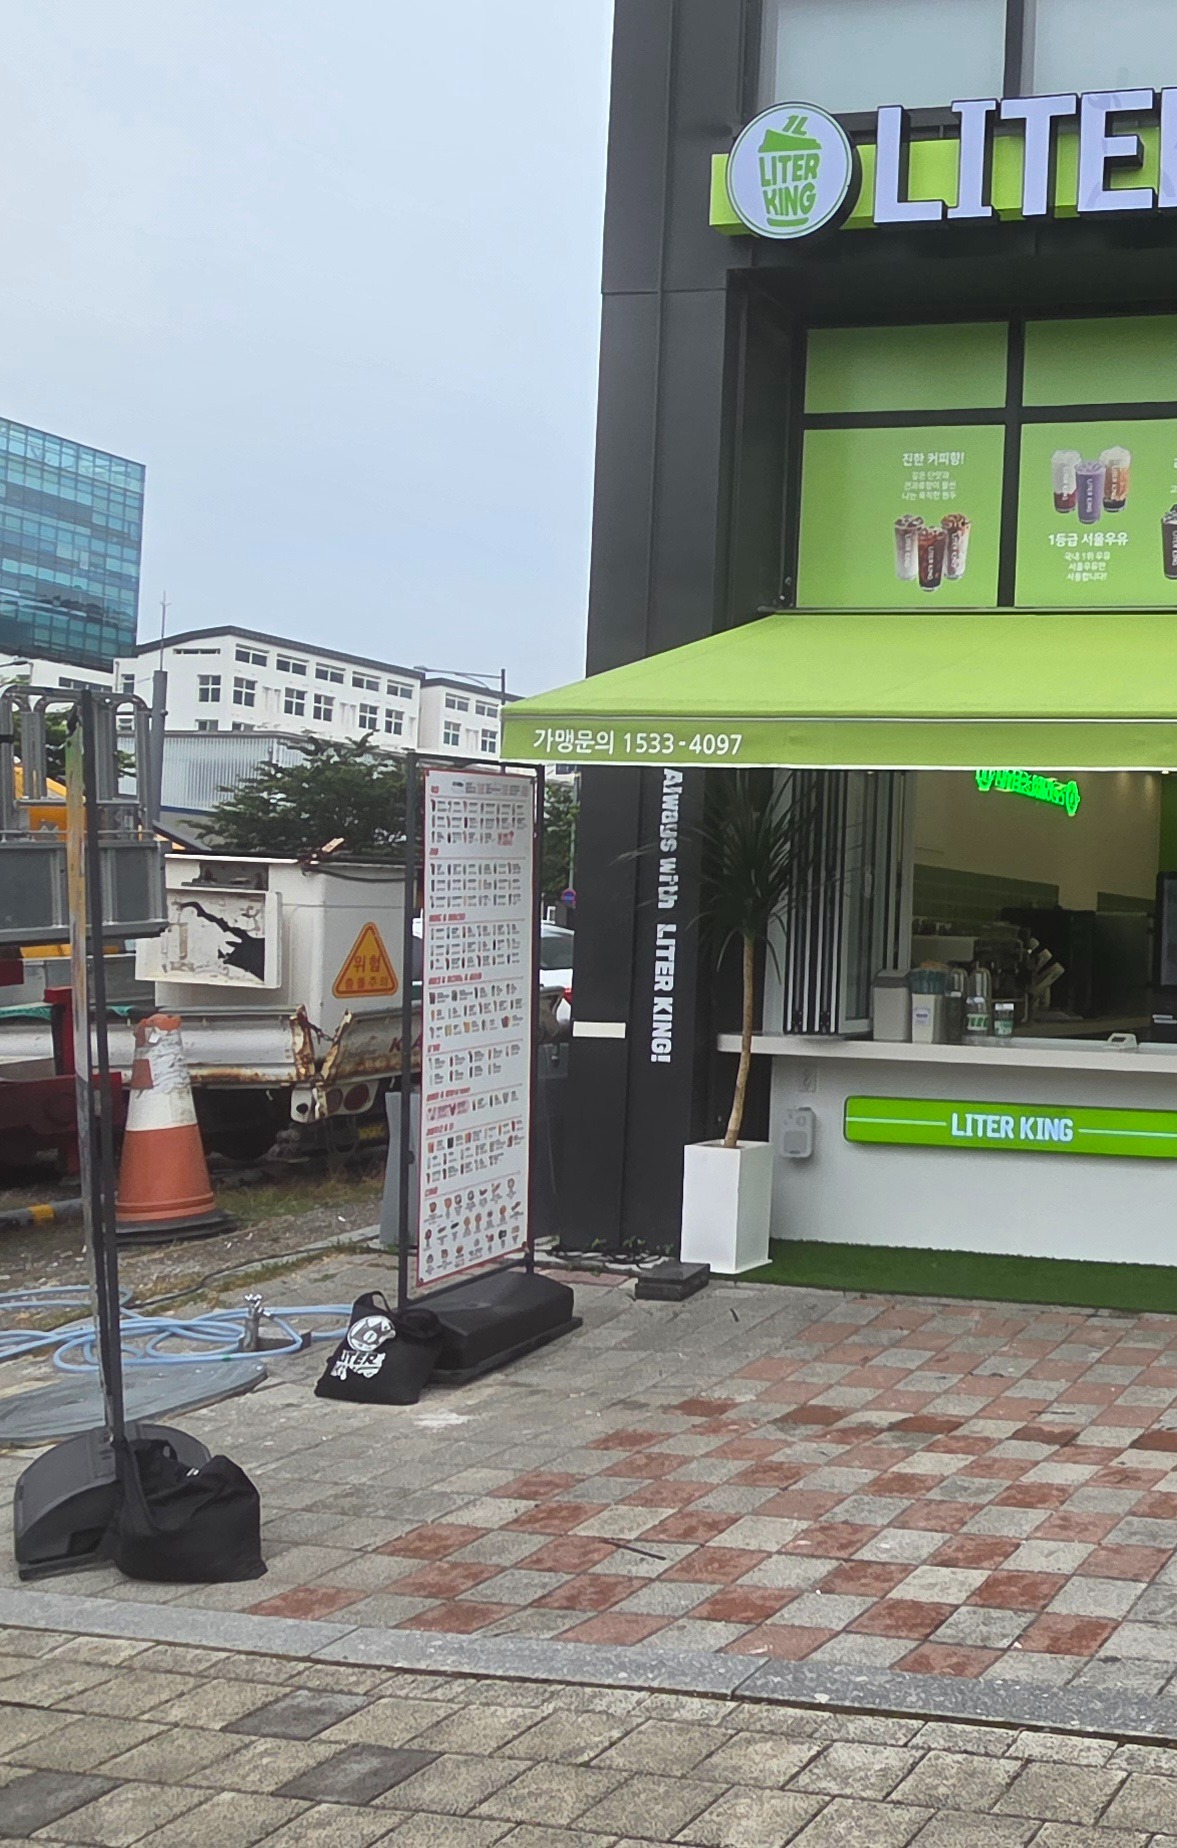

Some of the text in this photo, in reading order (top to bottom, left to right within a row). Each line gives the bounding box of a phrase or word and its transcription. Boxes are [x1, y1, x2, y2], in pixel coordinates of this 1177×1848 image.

[782, 115, 808, 136] 1L
[759, 153, 820, 187] LITER
[763, 182, 816, 216] KING
[902, 453, 924, 466] 진한
[1048, 532, 1128, 547] 1등급 서울우유
[533, 728, 743, 755] 가맹문의 1533-4097
[658, 857, 679, 909] with
[654, 924, 676, 992] LITER
[650, 996, 673, 1063] KING!
[952, 1112, 1074, 1142] LITER KING
